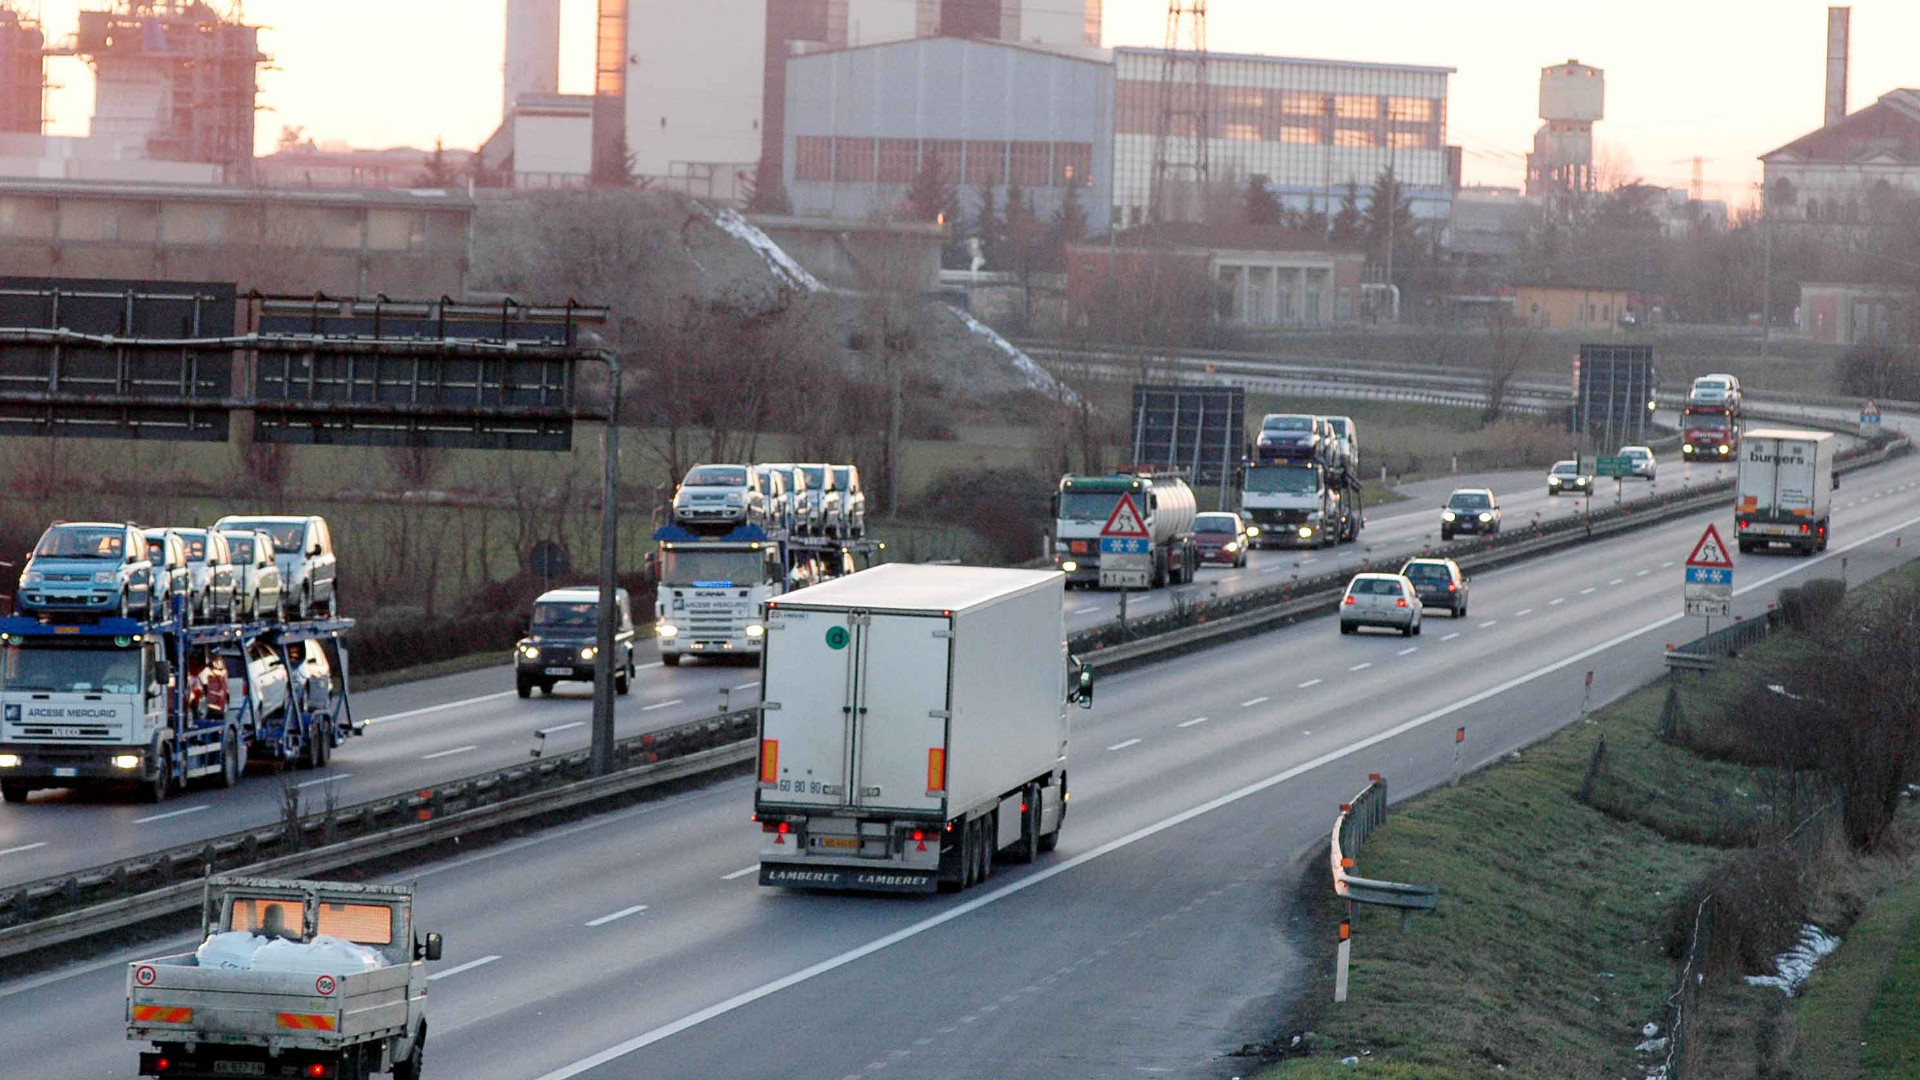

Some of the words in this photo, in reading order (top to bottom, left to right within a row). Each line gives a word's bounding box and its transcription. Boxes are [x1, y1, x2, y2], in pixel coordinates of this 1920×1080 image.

[28, 708, 64, 717] ARCESE
[67, 709, 117, 718] MERCURIO
[779, 780, 790, 792] 60
[794, 780, 805, 793] 80
[810, 781, 821, 794] 90
[768, 871, 839, 882] LAMBERET
[857, 874, 928, 886] LAMBERET
[140, 971, 151, 980] 80
[319, 980, 332, 990] 100
